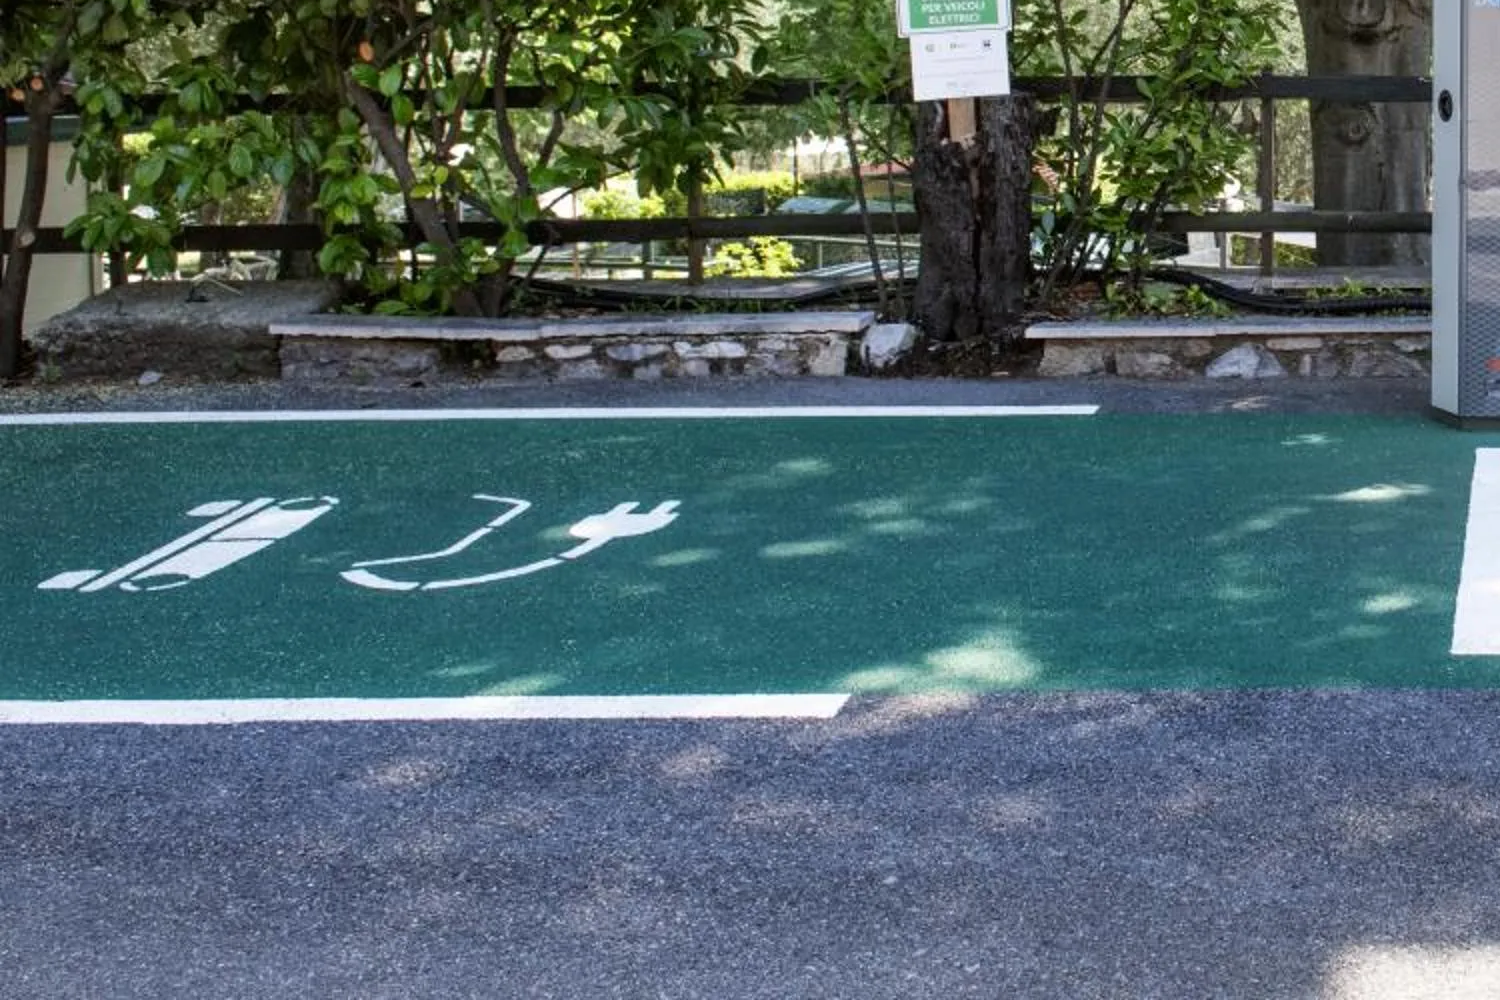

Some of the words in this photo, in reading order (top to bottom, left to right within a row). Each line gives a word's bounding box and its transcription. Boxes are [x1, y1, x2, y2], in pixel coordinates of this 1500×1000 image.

[921, 3, 942, 13] PER
[943, 0, 985, 12] VEICOLI
[928, 13, 980, 25] ELETTRICI
